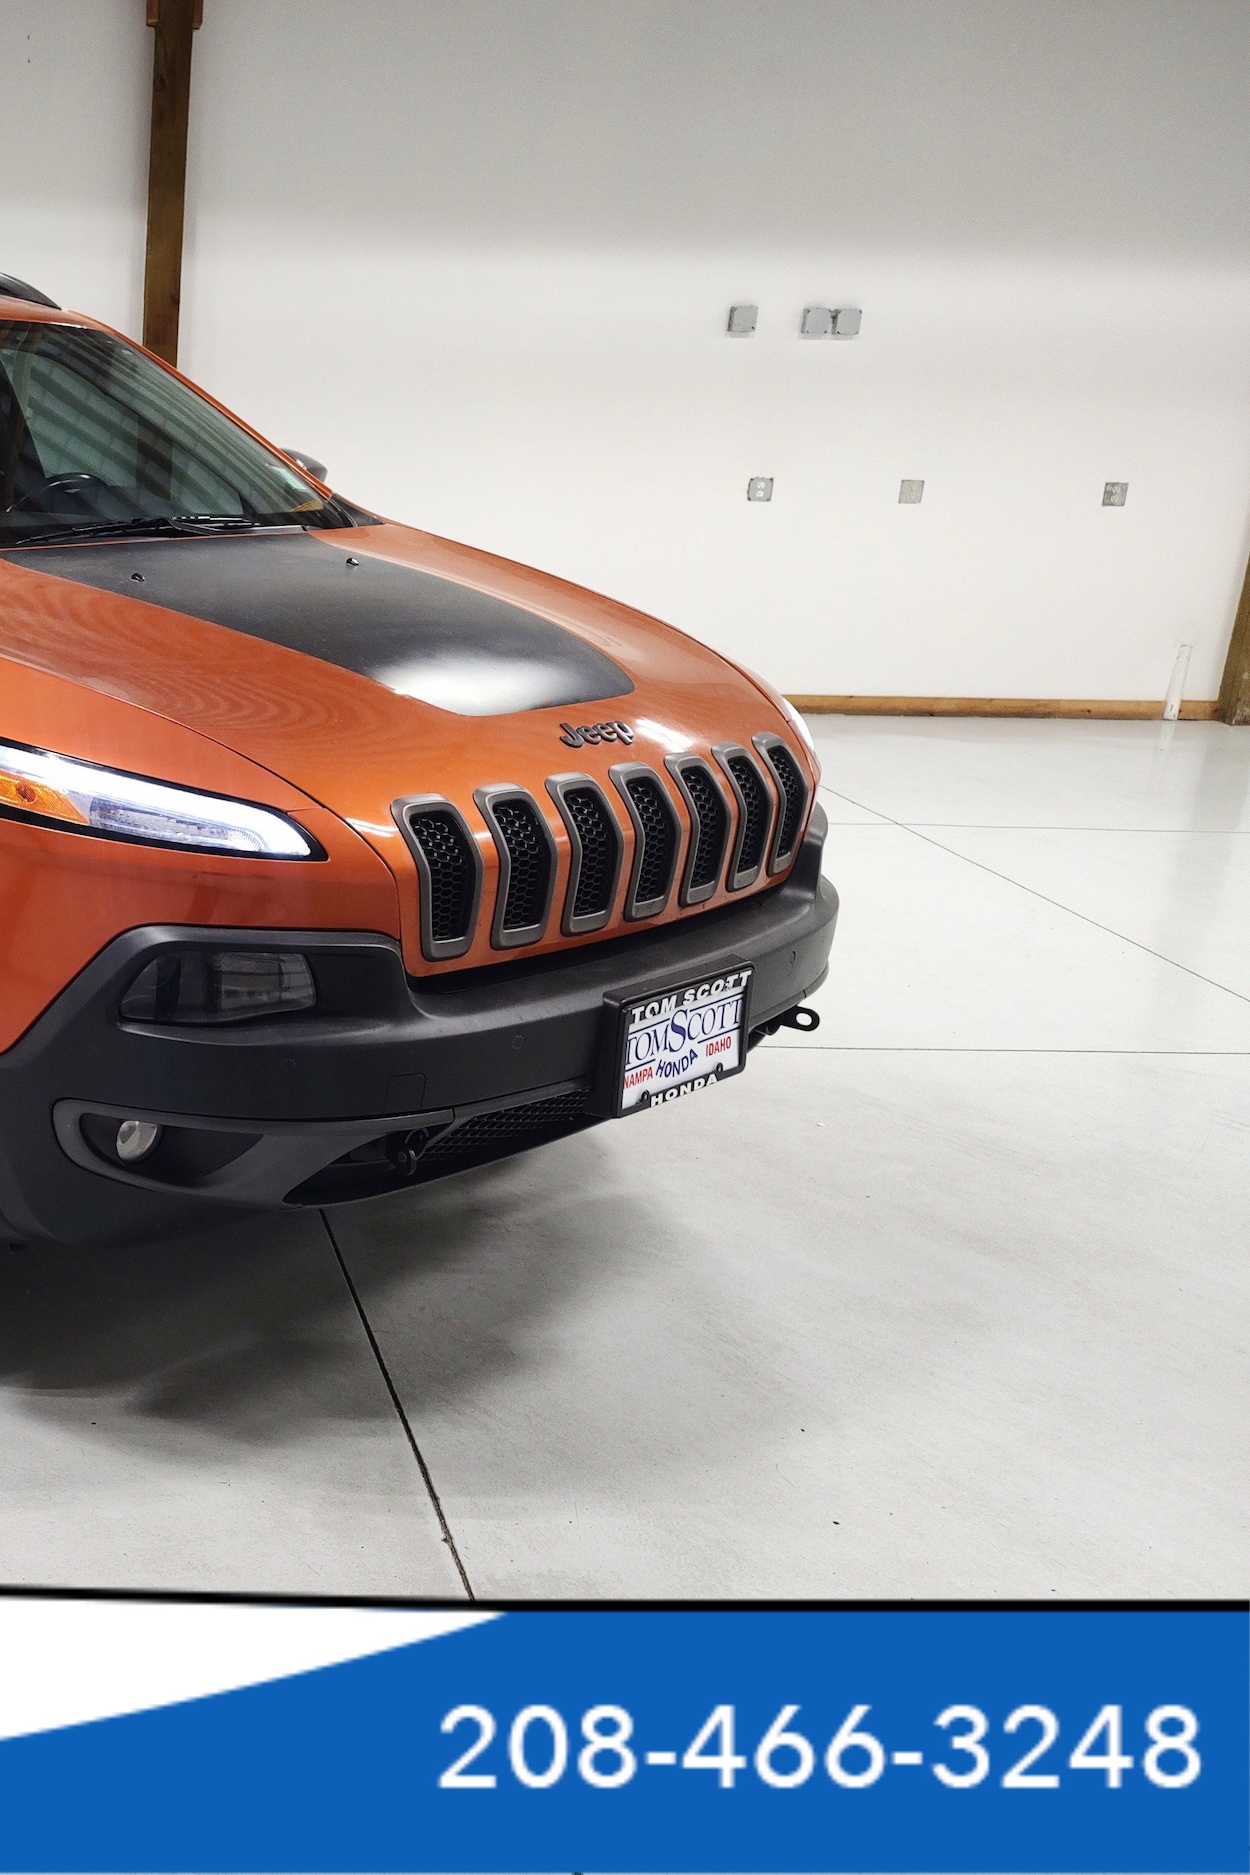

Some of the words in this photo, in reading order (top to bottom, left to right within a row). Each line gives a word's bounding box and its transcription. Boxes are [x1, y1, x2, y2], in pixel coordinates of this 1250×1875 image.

[559, 720, 634, 748] Jeep
[631, 994, 678, 1024] TOM
[683, 970, 752, 1006] SCOTT
[623, 1066, 654, 1089] NAMPA
[655, 1048, 699, 1078] HONDA
[705, 1036, 732, 1057] IDAHO
[650, 1073, 718, 1107] HONDA
